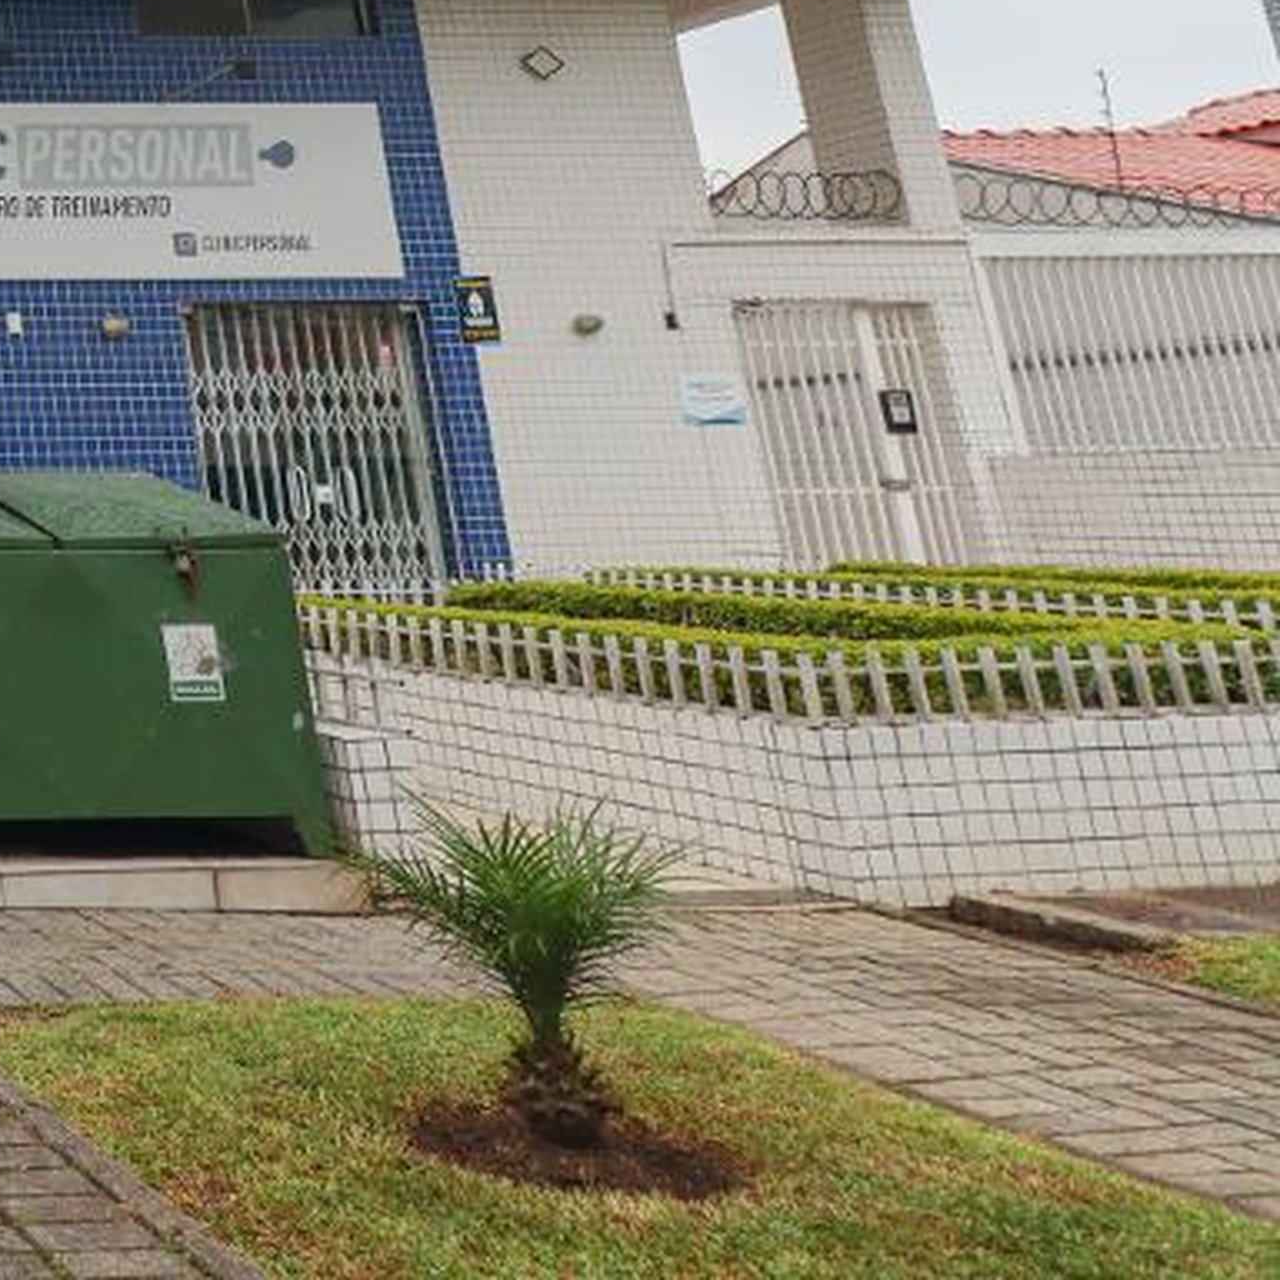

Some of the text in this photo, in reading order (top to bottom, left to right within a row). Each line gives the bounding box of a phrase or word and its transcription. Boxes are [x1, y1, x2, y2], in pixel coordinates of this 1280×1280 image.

[24, 128, 250, 182] PERSONAL
[24, 195, 47, 218] DE
[50, 194, 172, 218] TREINAMENTO
